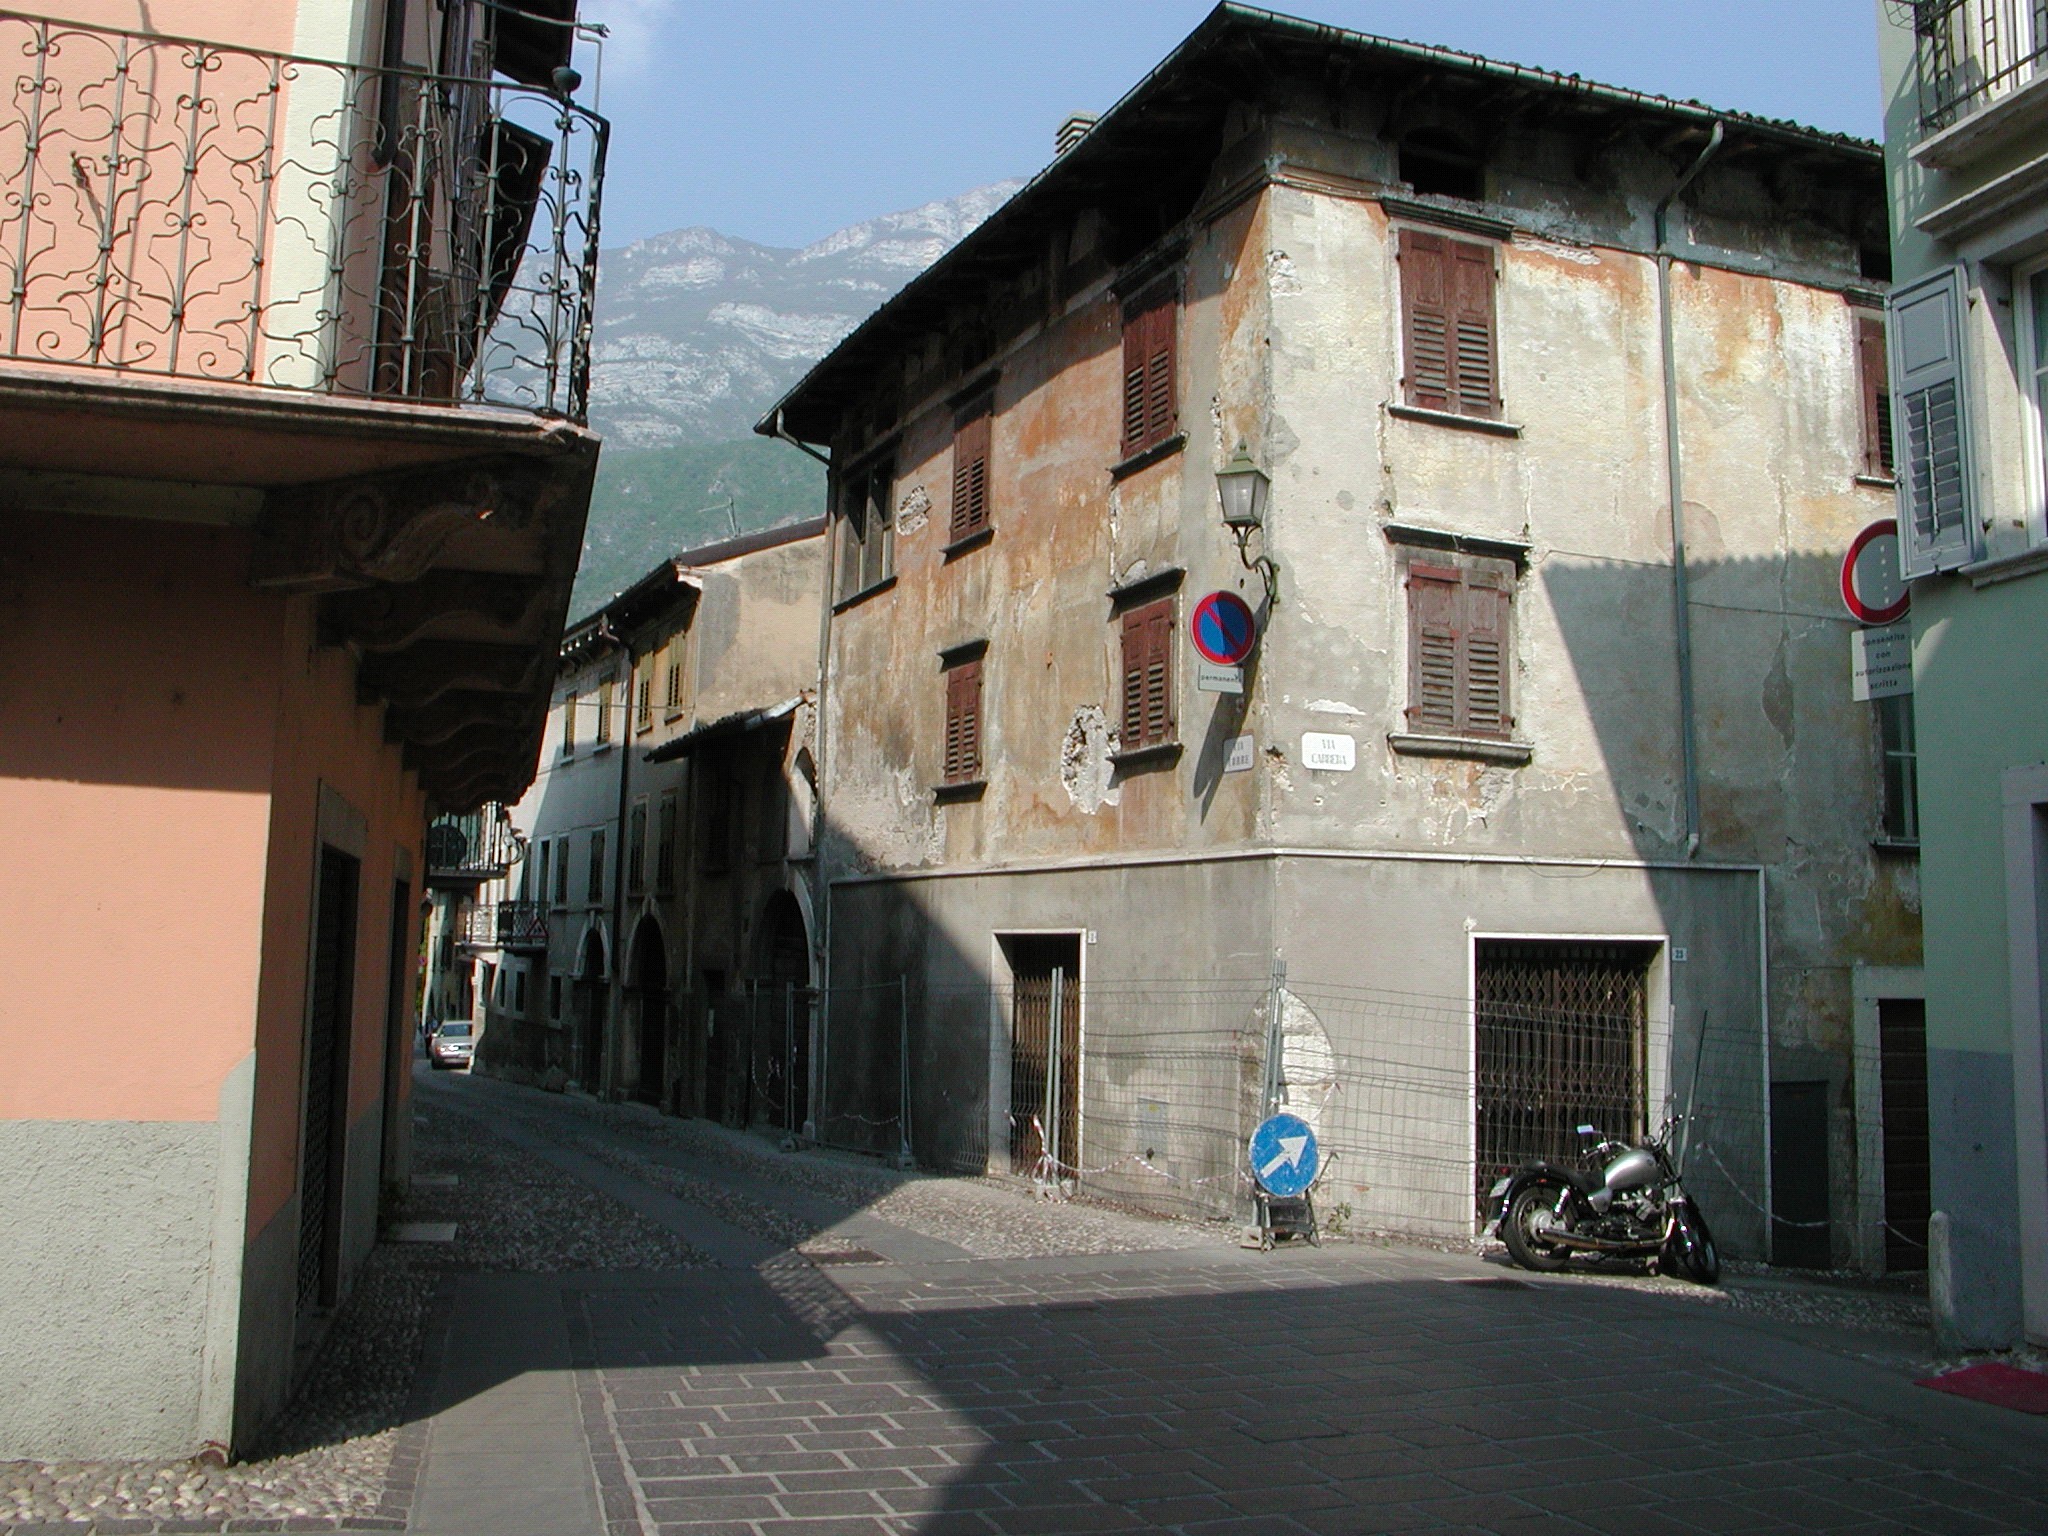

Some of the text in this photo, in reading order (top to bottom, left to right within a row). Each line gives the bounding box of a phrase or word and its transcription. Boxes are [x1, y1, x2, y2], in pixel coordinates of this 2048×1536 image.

[1875, 651, 1891, 660] con
[1869, 679, 1898, 690] scritta
[1321, 739, 1336, 750] VIA
[1311, 753, 1347, 765] CARRERA
